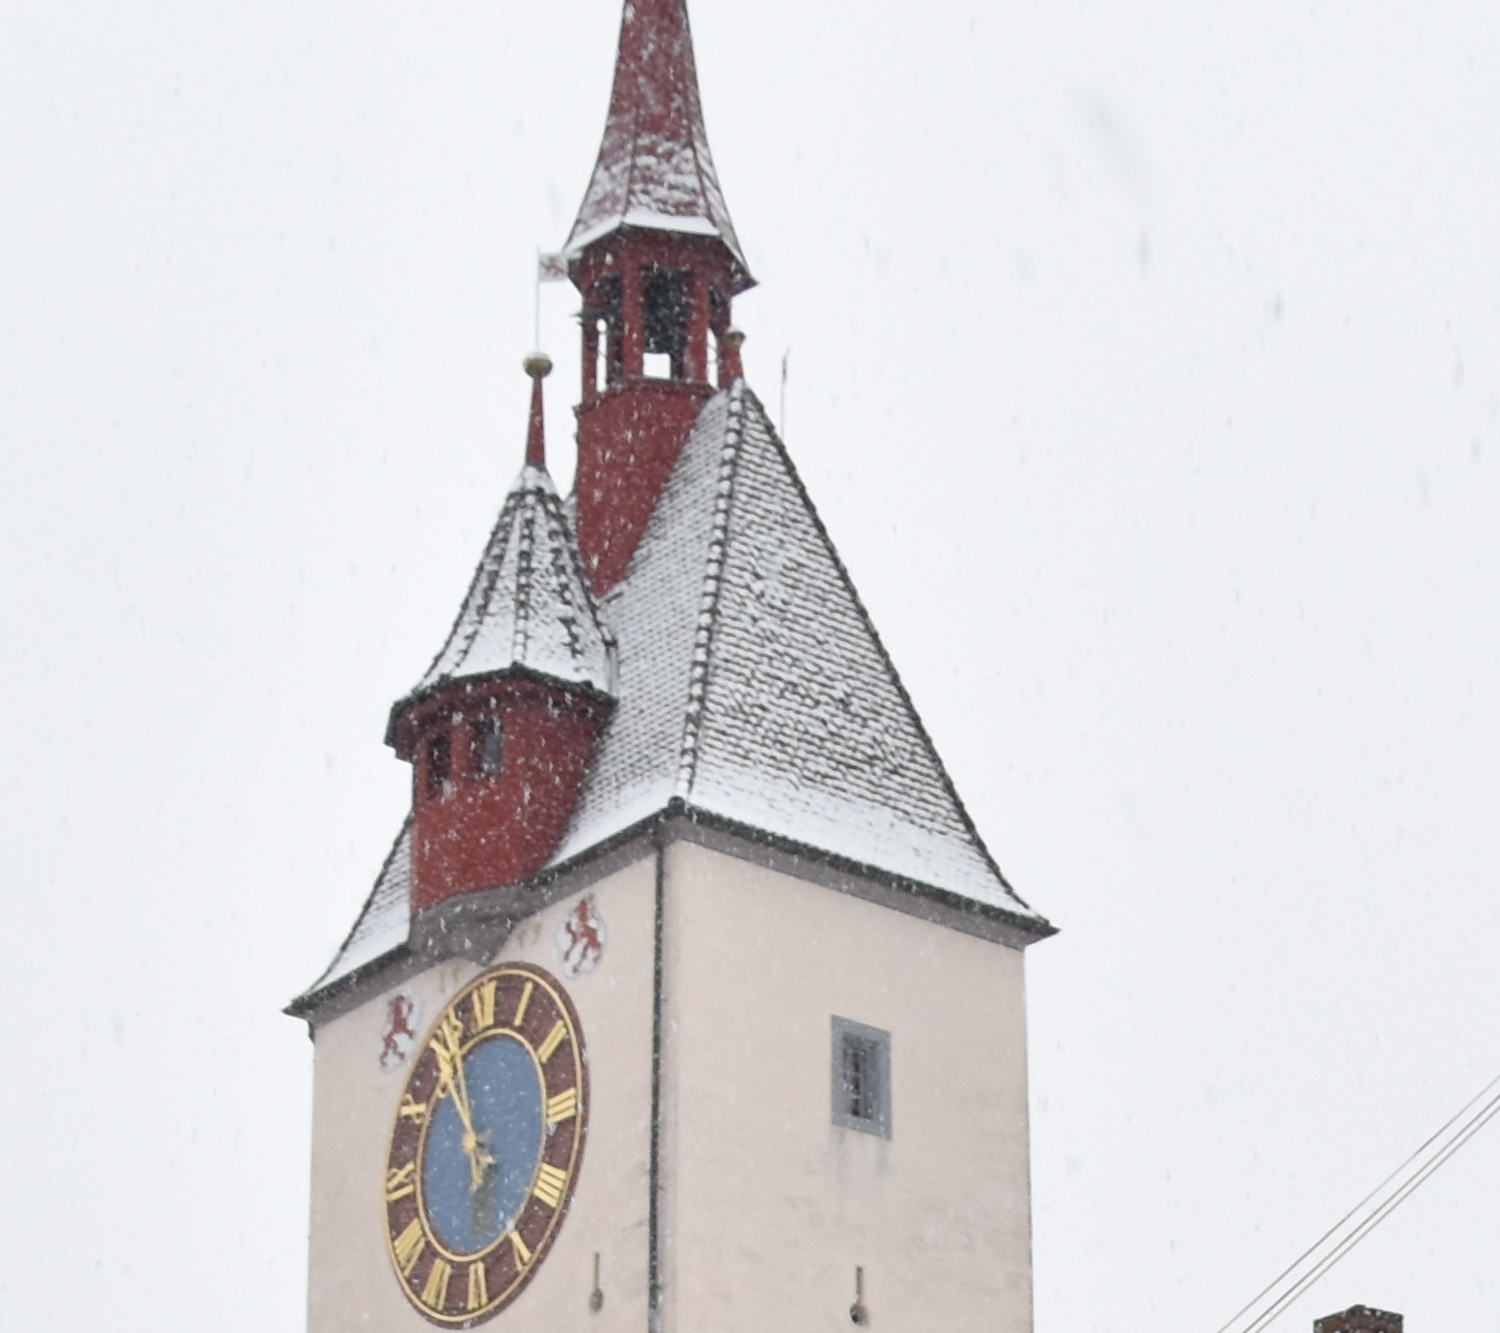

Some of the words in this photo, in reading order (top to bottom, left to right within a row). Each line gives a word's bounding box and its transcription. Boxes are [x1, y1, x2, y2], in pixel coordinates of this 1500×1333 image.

[537, 1019, 567, 1064] II
[401, 1093, 427, 1124] X
[547, 1087, 577, 1124] III
[386, 1162, 415, 1202] IX
[533, 1162, 567, 1208] IIII
[510, 1230, 532, 1272] V
